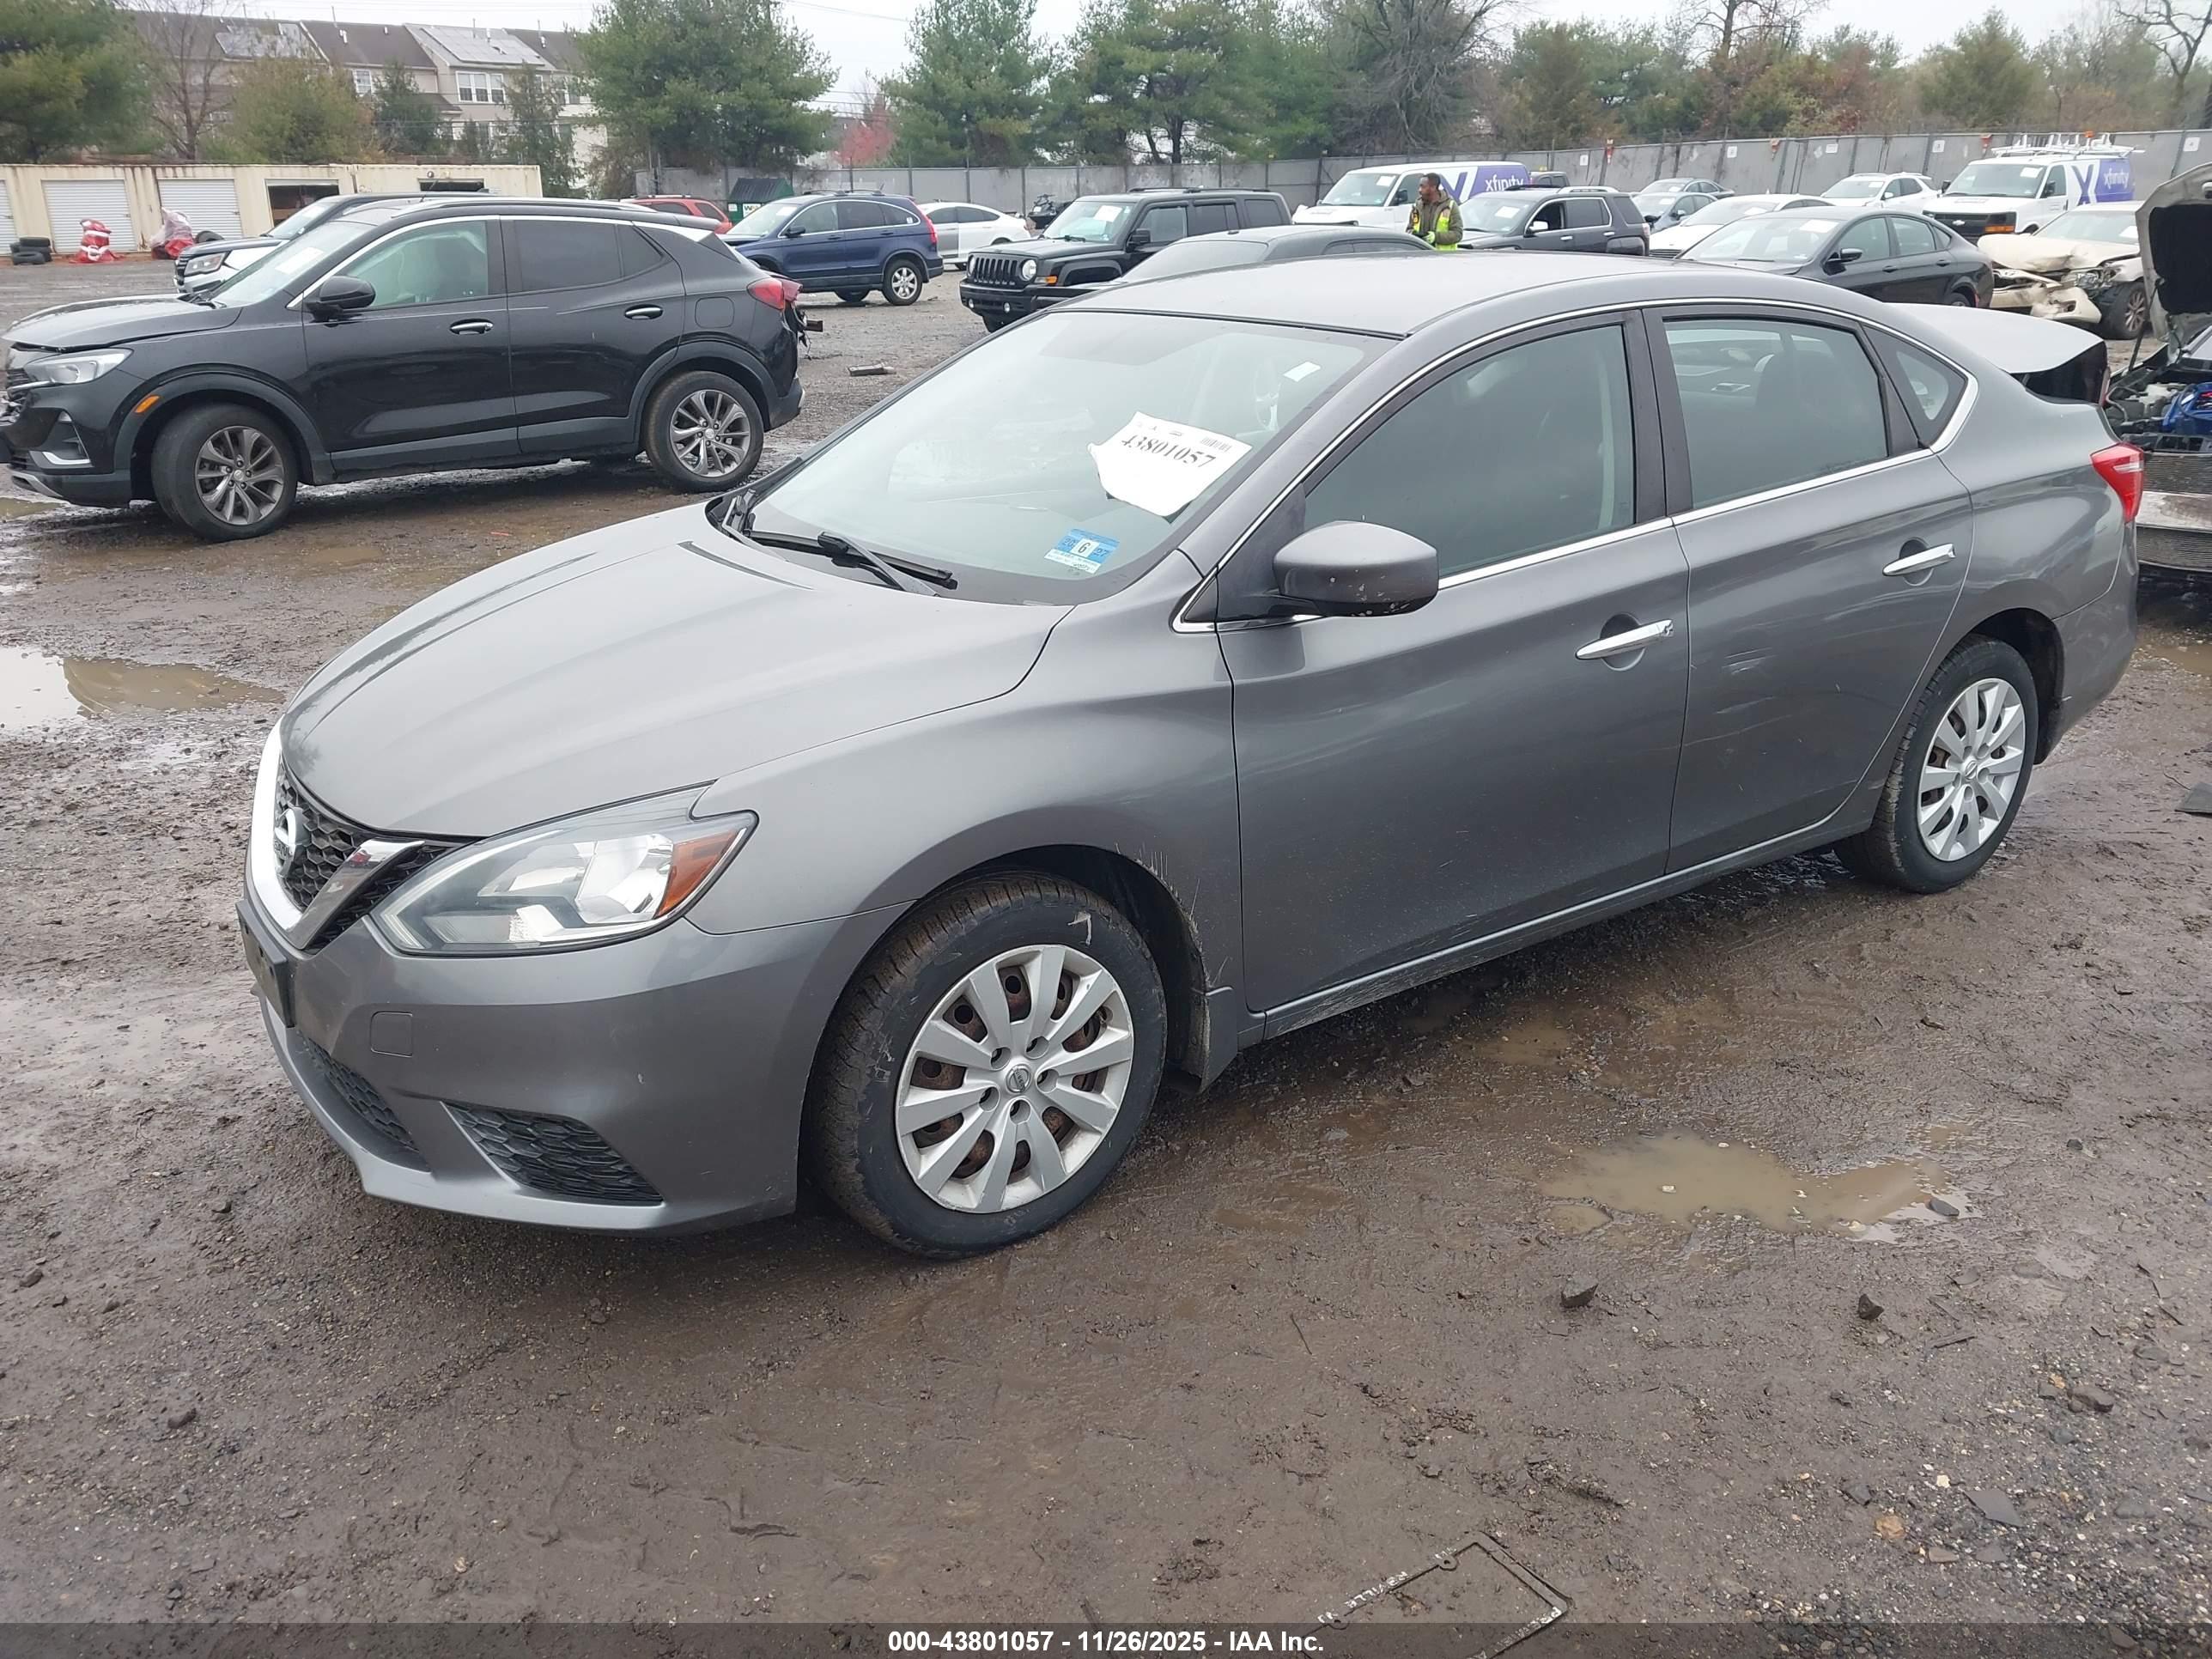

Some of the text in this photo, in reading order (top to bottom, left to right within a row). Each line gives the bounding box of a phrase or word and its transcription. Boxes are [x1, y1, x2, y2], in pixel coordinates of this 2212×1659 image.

[2103, 167, 2130, 189] xfinity
[1121, 434, 1217, 468] 43801057
[1078, 542, 1091, 554] 6
